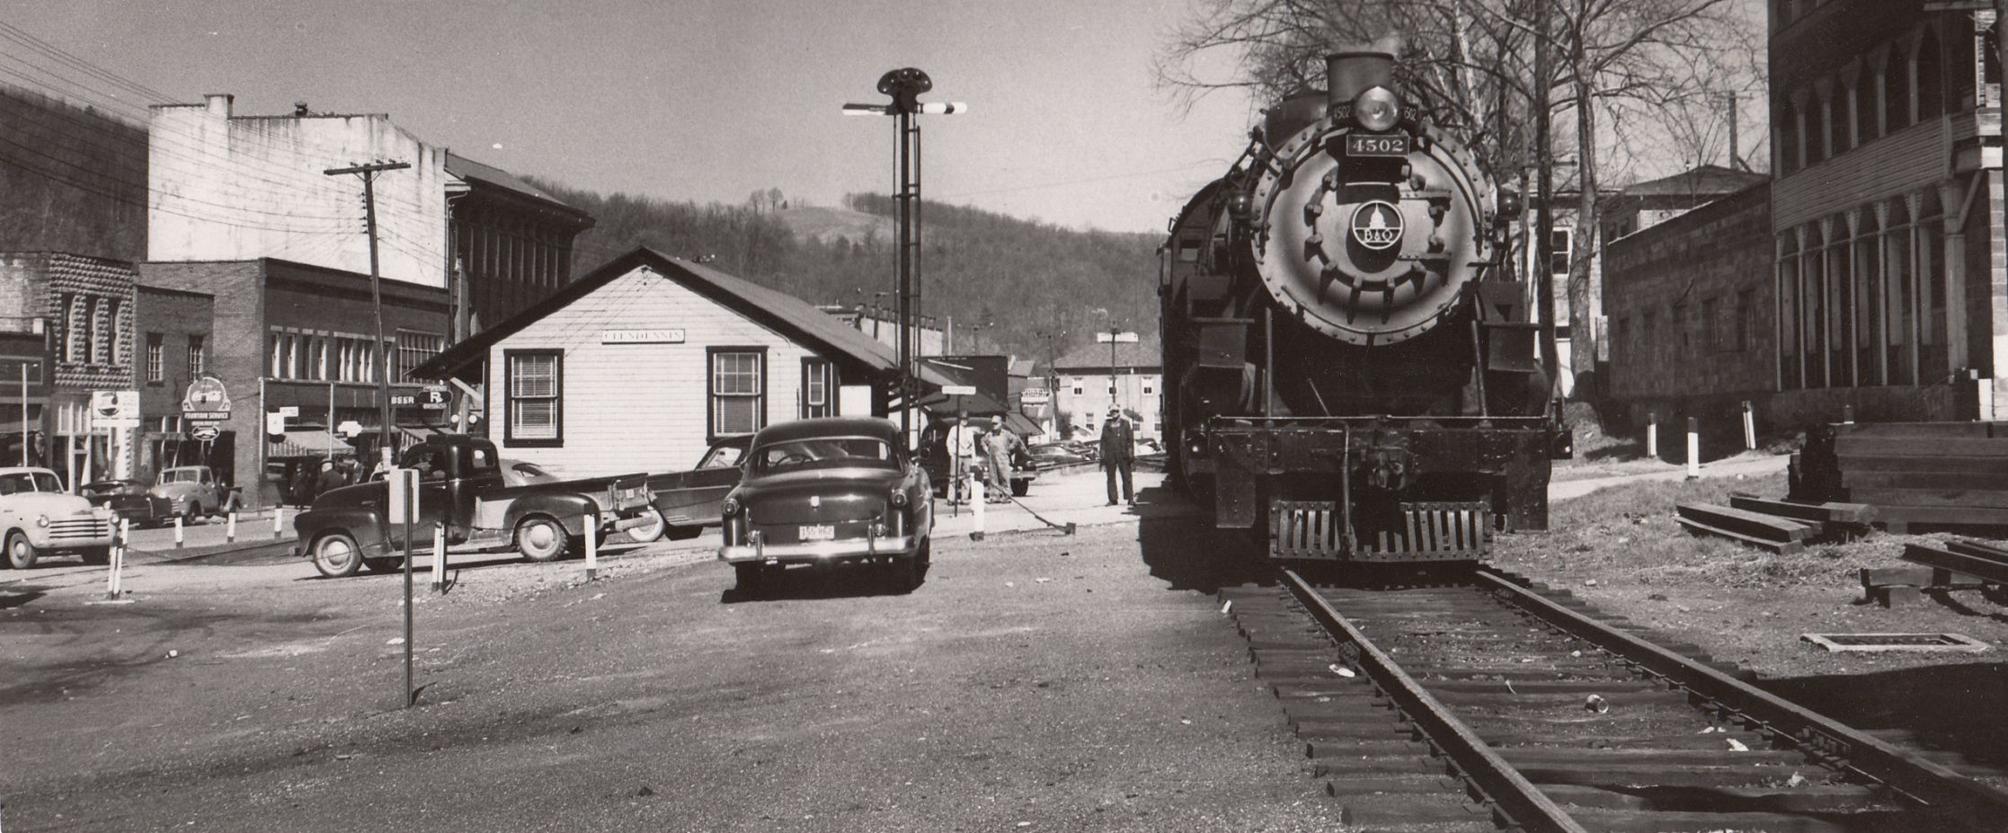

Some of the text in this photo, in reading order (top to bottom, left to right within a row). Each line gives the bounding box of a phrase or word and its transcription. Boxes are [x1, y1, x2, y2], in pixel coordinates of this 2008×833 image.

[1353, 139, 1404, 152] 4502
[1364, 228, 1393, 242] B&O
[391, 396, 415, 404] BEER
